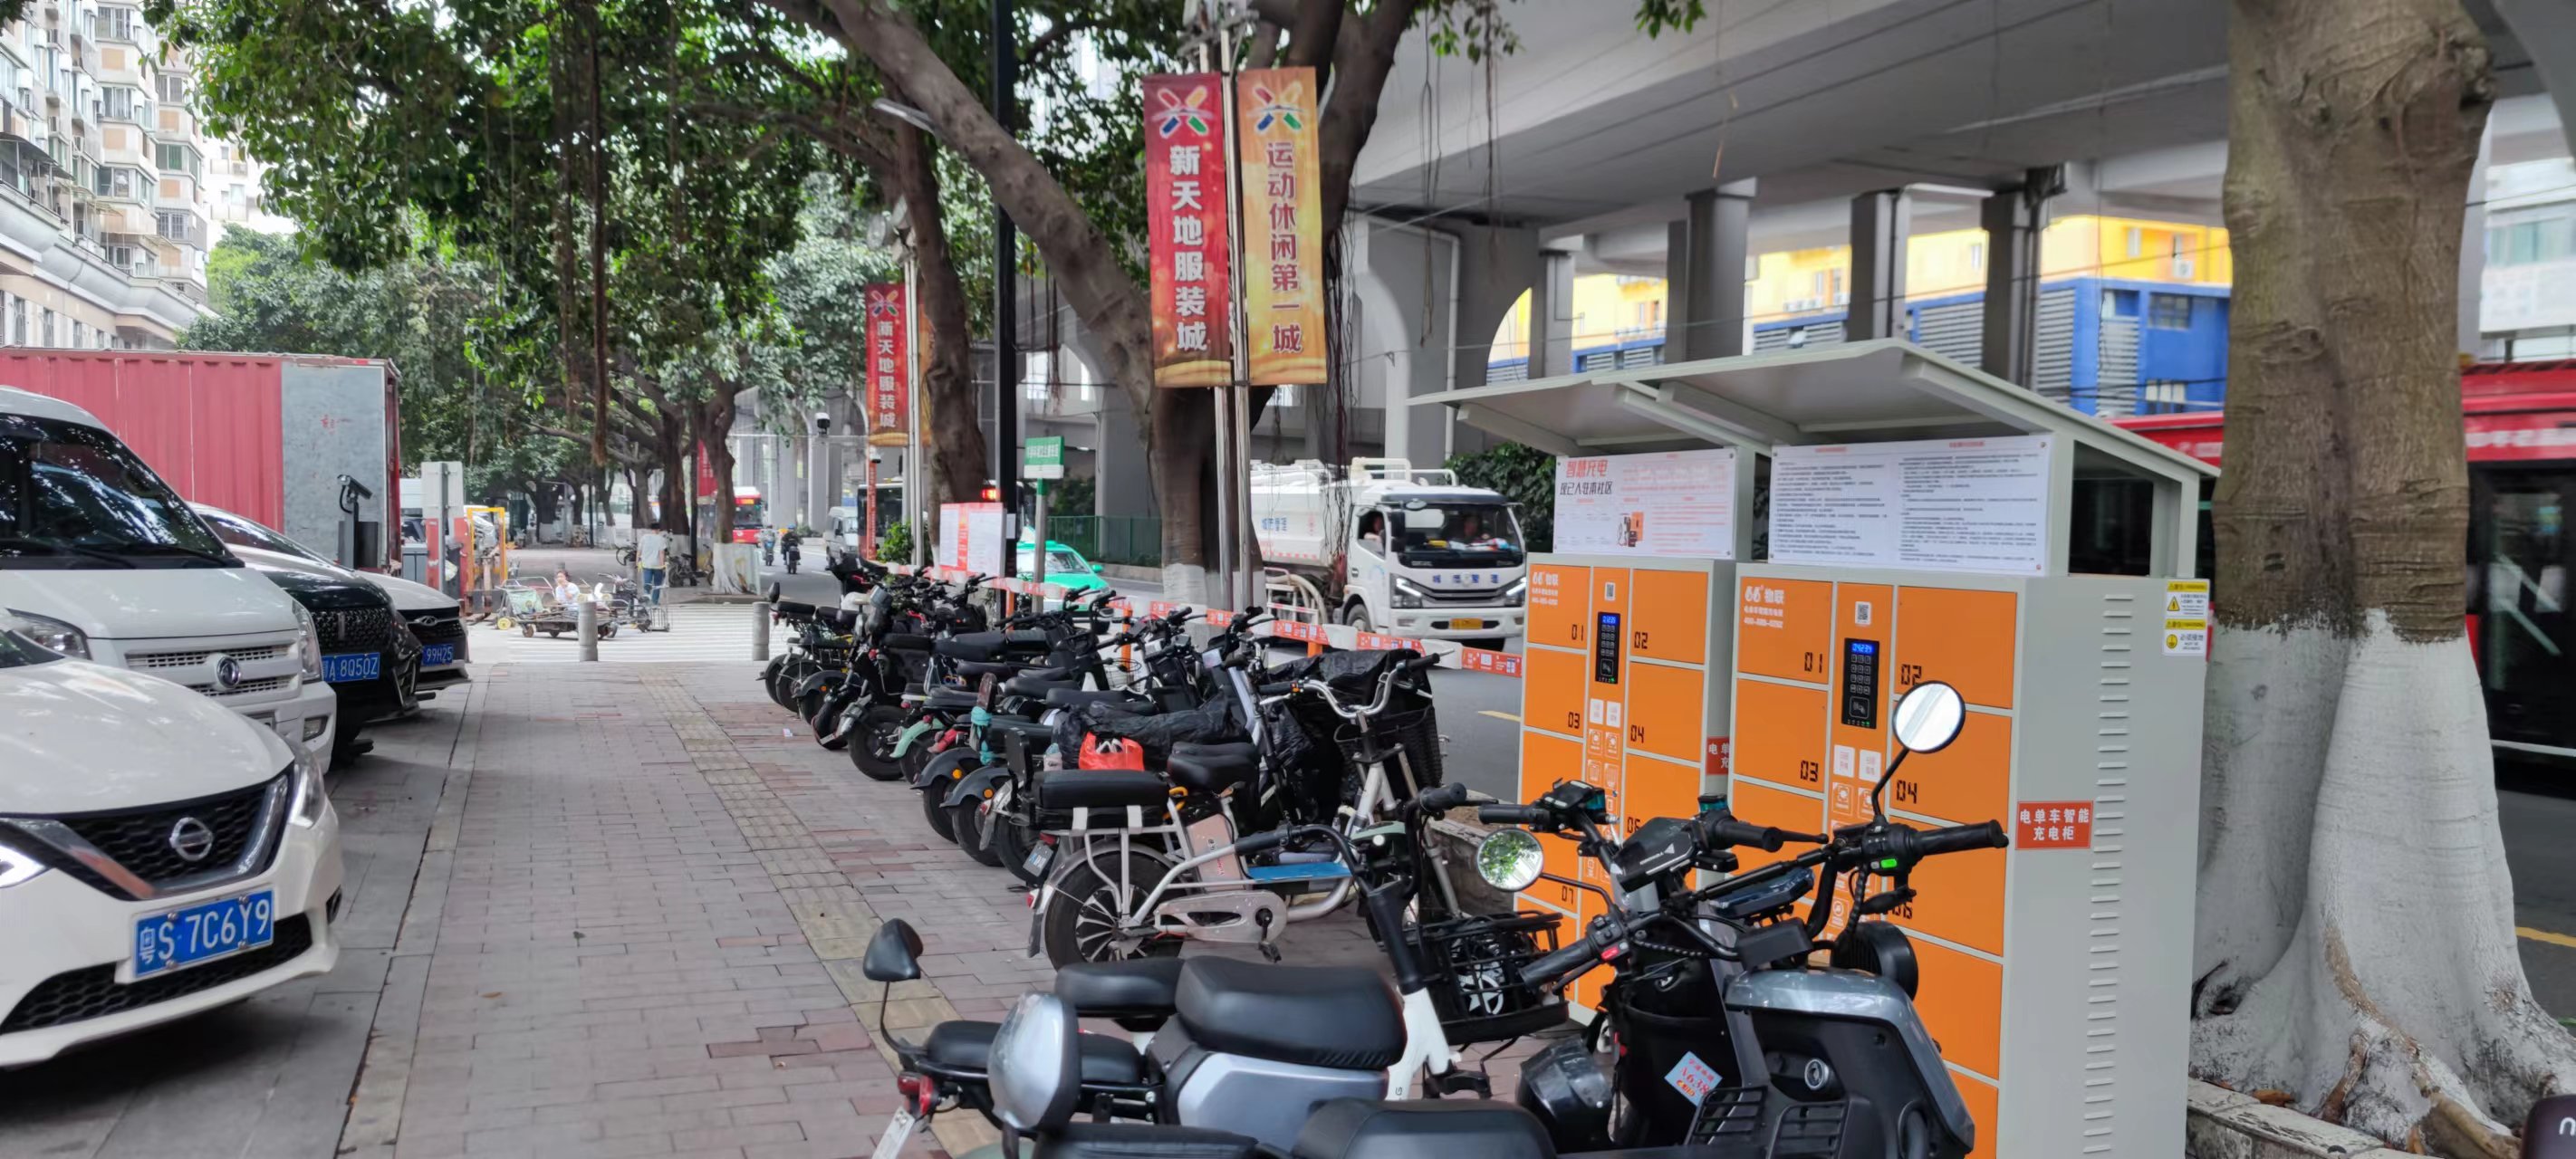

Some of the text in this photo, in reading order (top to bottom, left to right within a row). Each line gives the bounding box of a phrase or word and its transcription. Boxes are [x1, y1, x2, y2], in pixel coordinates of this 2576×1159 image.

[1169, 145, 1207, 352] 新天地服装城
[1266, 142, 1302, 353] 运动休闲第一城
[877, 321, 896, 427] 新天地服装城
[1566, 459, 1609, 478] 智慧充电
[1572, 624, 1583, 641] 01
[1634, 632, 1648, 649] 02
[1804, 652, 1822, 674] 01
[1901, 664, 1921, 685] 02
[1568, 712, 1580, 729] 03
[1630, 725, 1645, 743] 04
[1801, 760, 1818, 782] 03
[1897, 780, 1918, 804] 04
[2020, 808, 2090, 825] 电单车智能
[2033, 826, 2074, 840] 充电柜
[1562, 886, 1573, 905] 07
